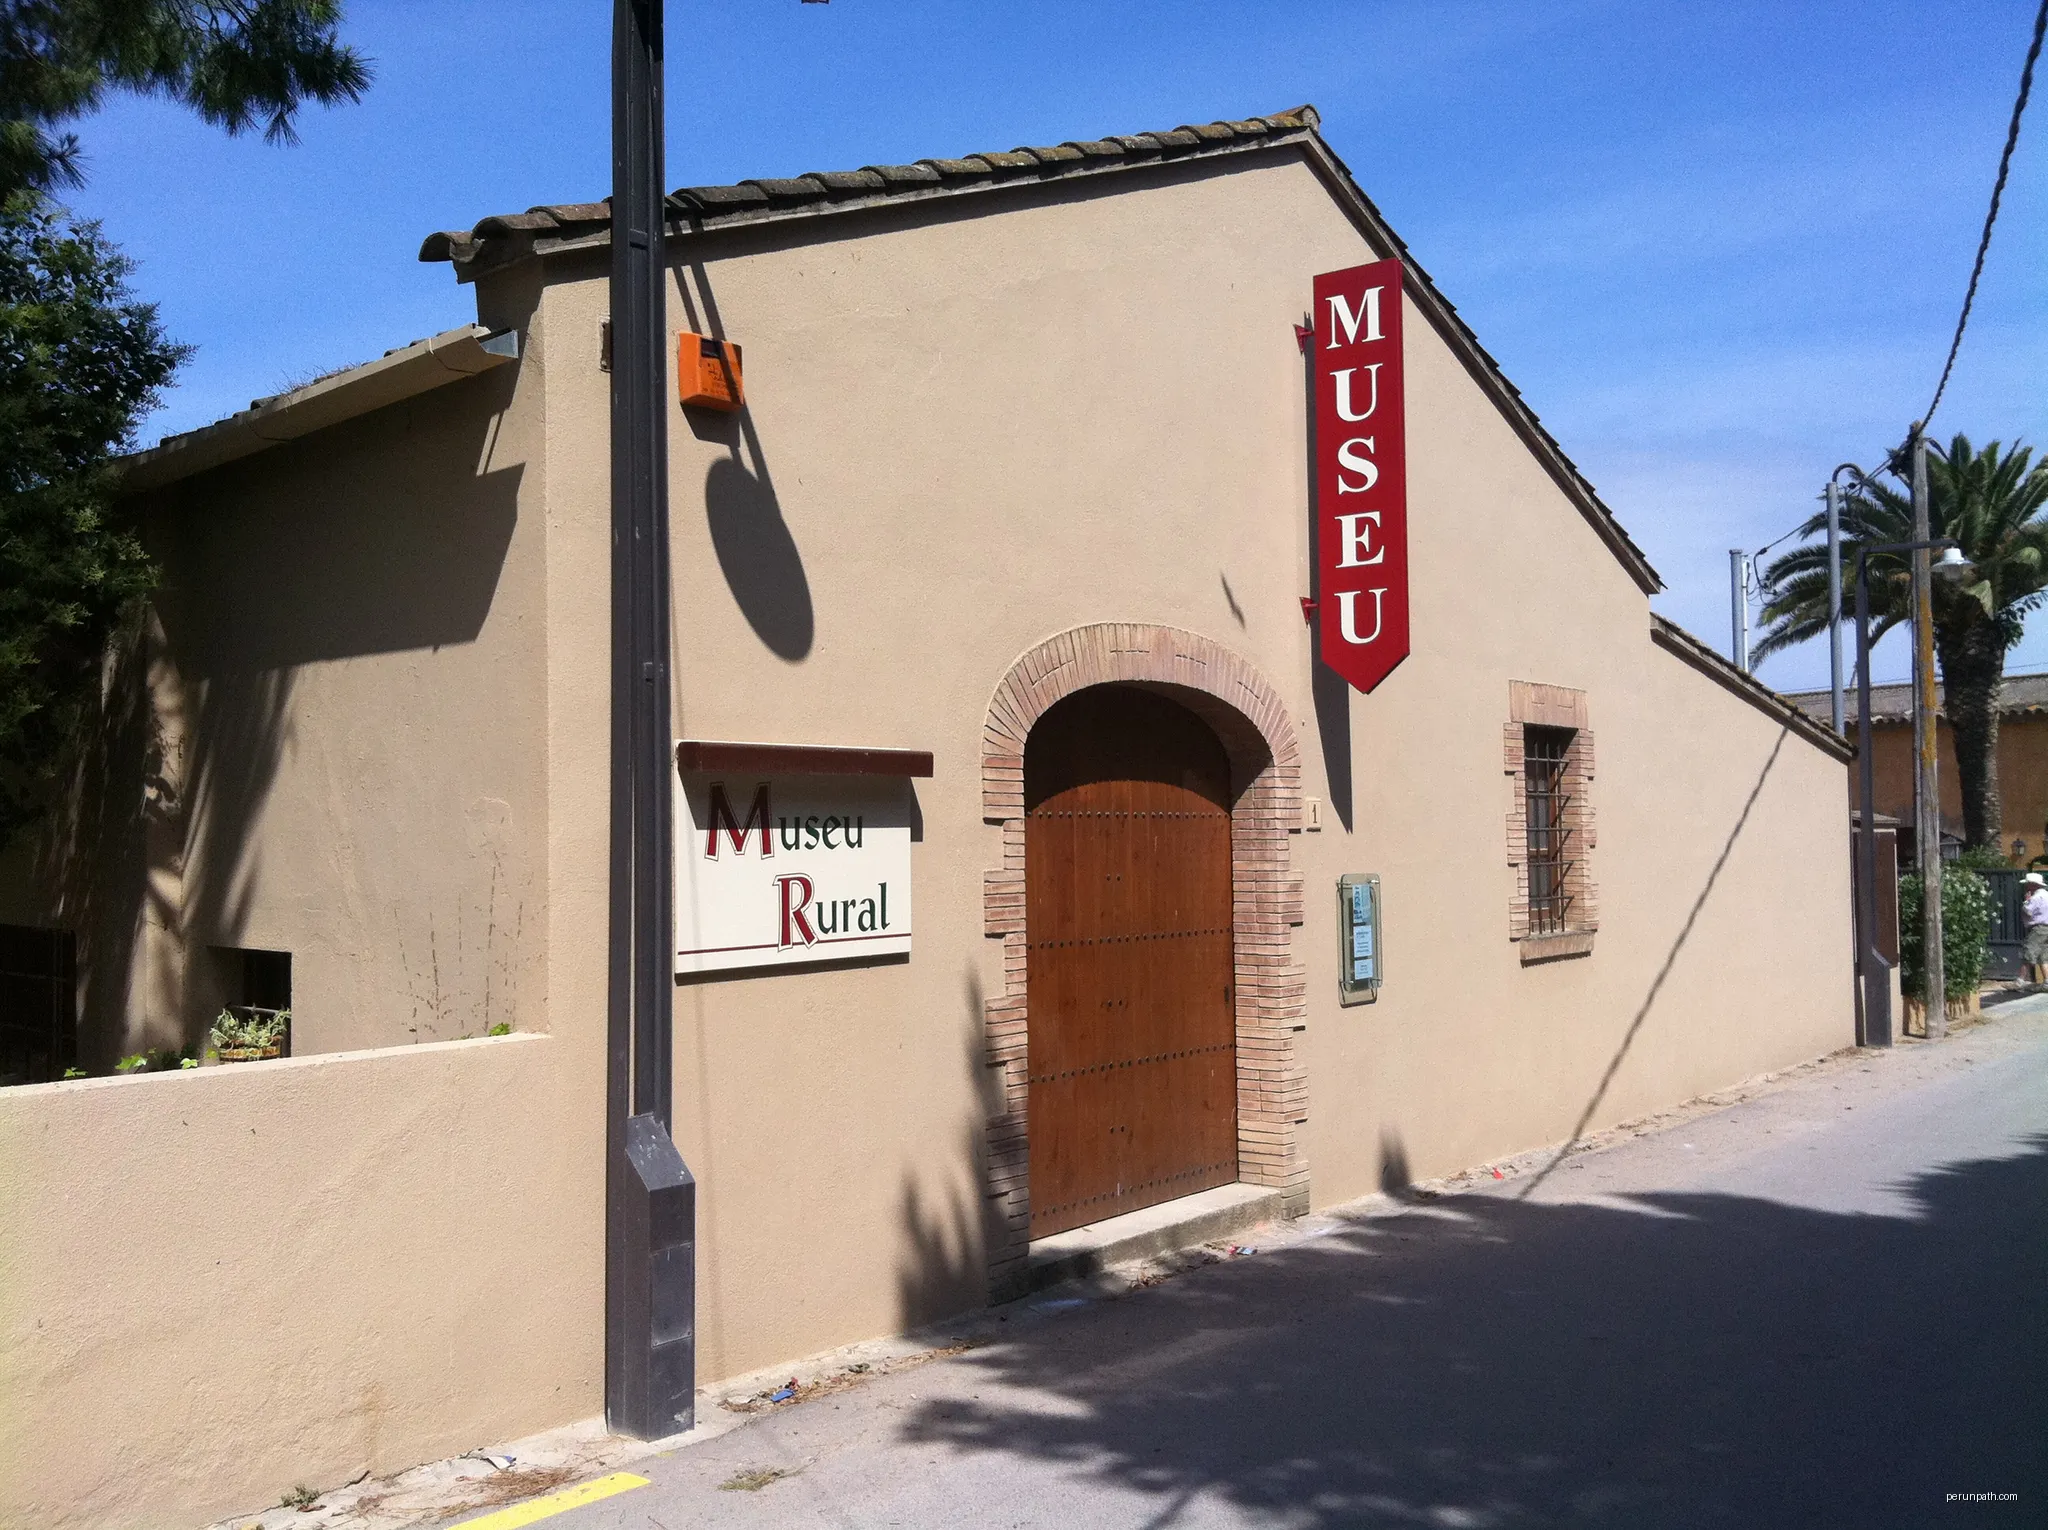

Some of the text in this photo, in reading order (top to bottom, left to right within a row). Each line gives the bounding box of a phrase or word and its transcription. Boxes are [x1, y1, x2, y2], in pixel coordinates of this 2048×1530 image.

[1325, 286, 1388, 645] MUSEU
[704, 781, 863, 861] Museu
[1311, 804, 1318, 824] 1
[772, 872, 890, 952] Rural
